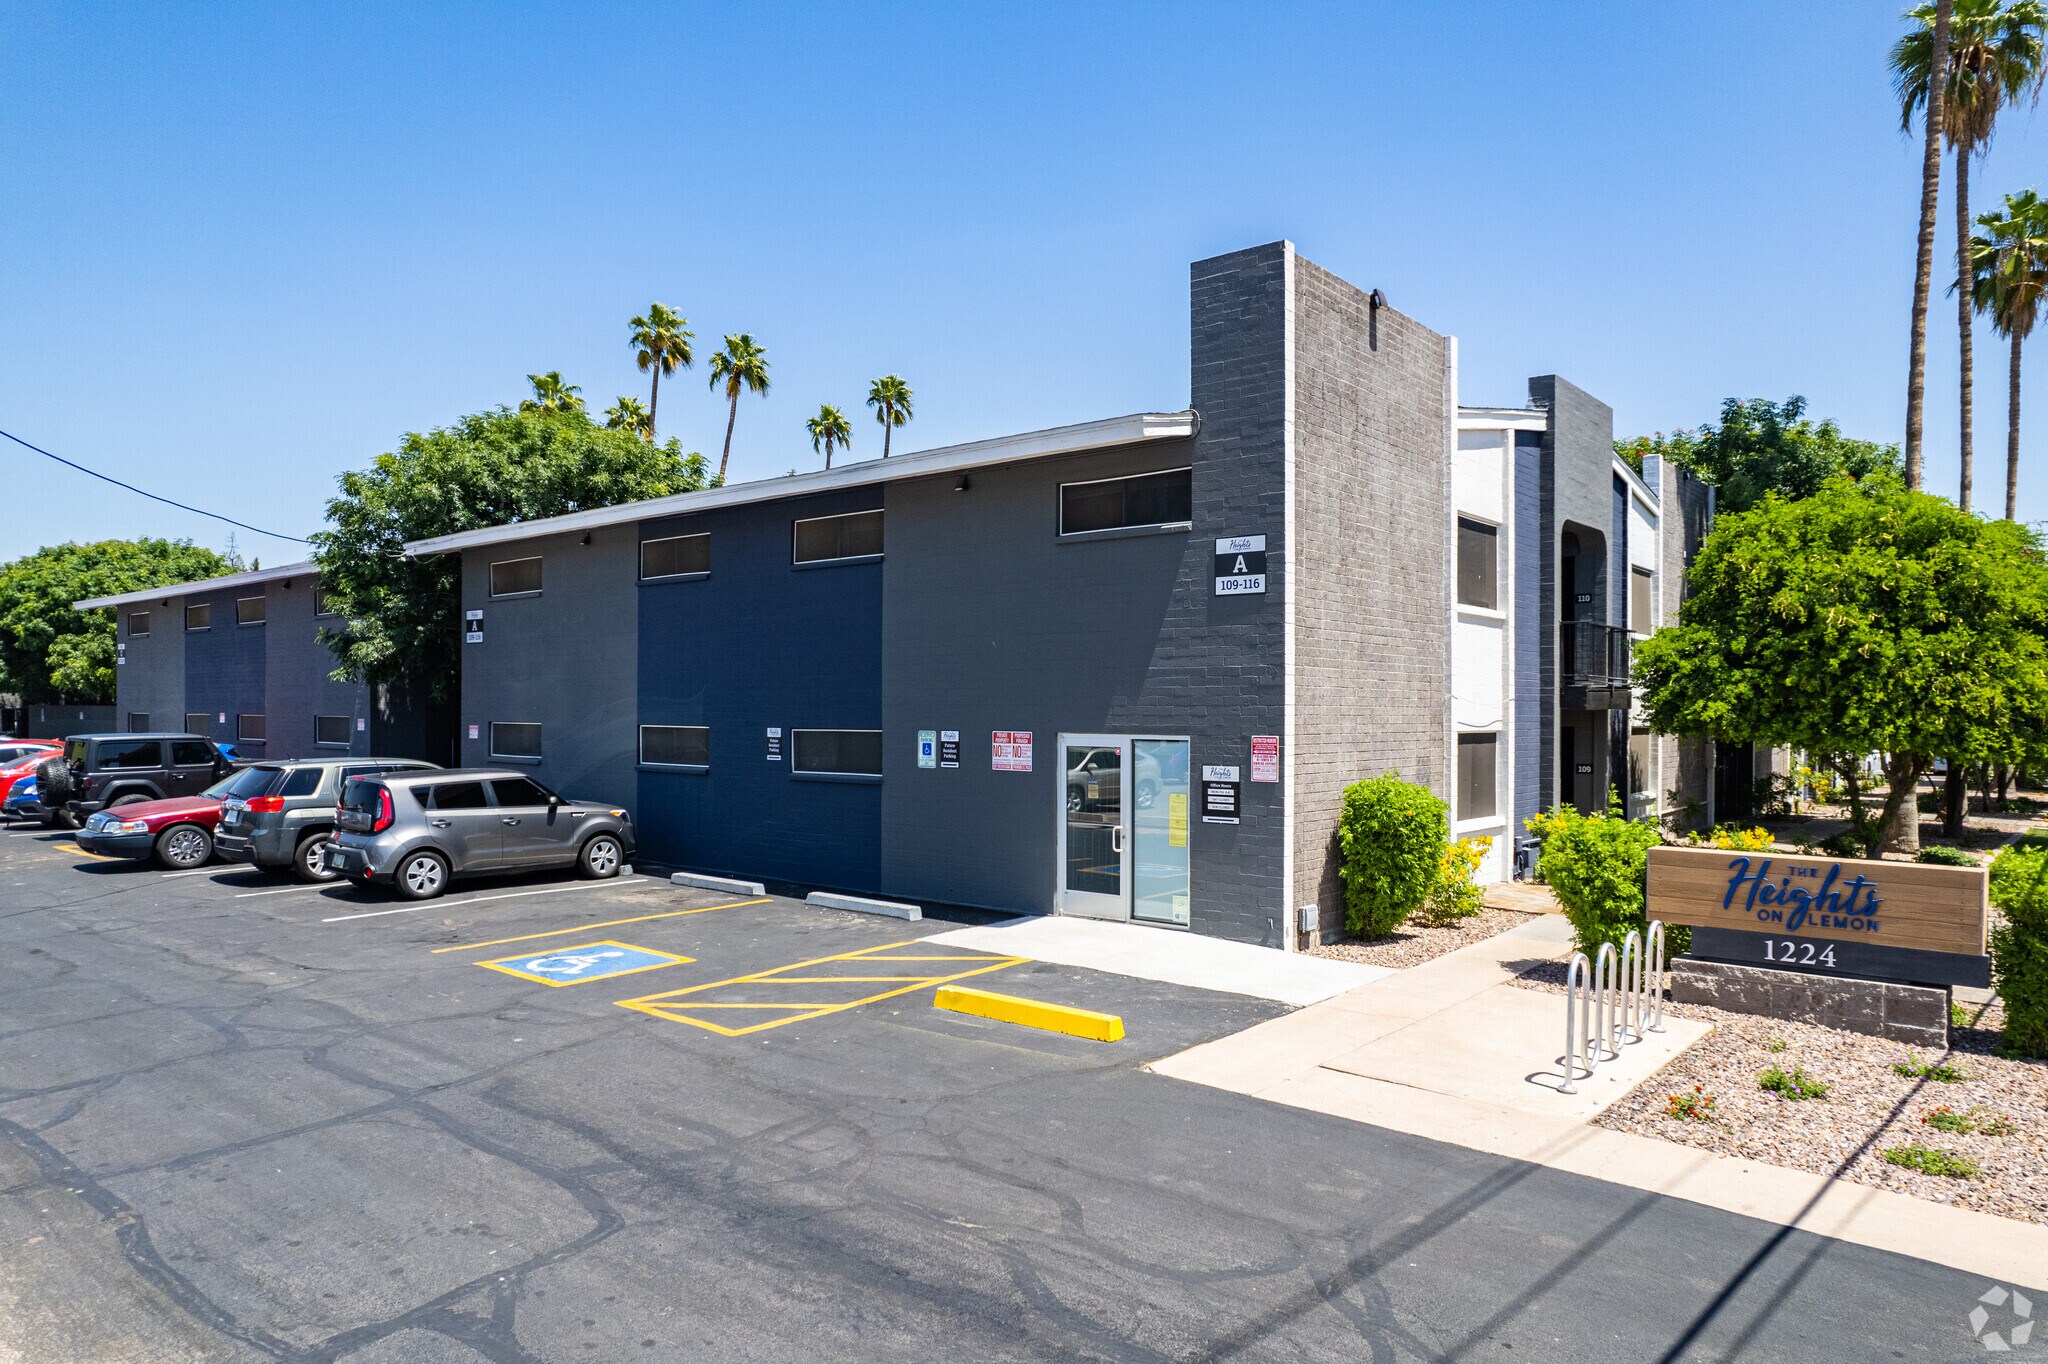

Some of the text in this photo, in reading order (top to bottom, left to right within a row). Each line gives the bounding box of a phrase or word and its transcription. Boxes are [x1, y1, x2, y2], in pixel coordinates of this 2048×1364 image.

[1232, 554, 1248, 573] A
[1221, 578, 1260, 590] 109-116
[471, 620, 478, 631] A
[993, 744, 1002, 757] NO
[1012, 745, 1022, 758] NO
[1210, 766, 1232, 780] Heights
[1578, 765, 1591, 773] 109
[1788, 865, 1818, 878] THE
[1723, 857, 1884, 932] Heights
[1757, 909, 1879, 932] ON LEMON
[1764, 940, 1837, 968] 1224
